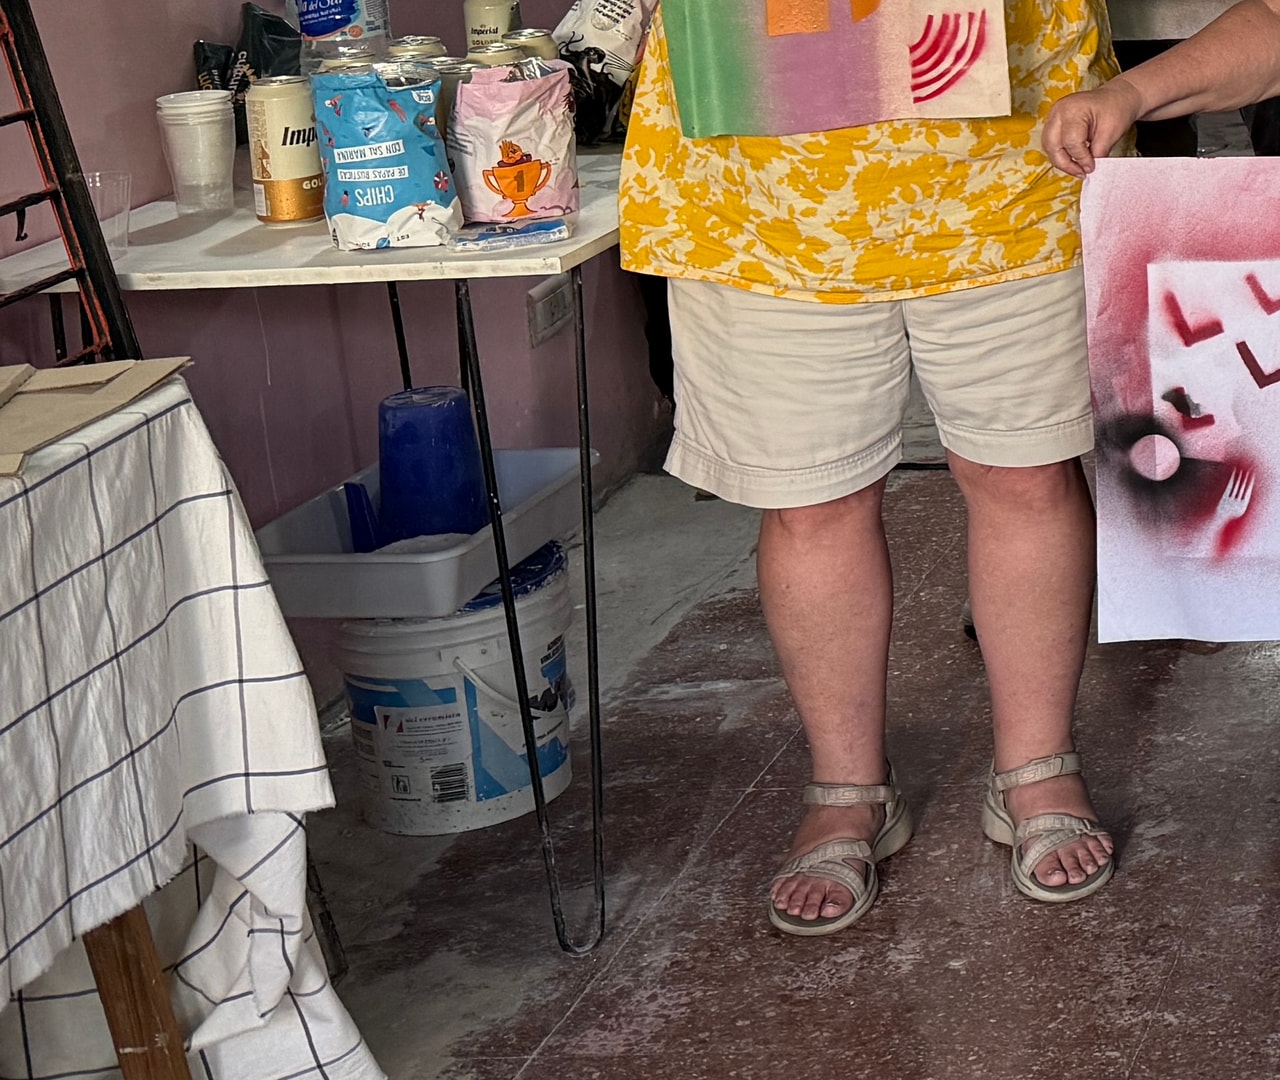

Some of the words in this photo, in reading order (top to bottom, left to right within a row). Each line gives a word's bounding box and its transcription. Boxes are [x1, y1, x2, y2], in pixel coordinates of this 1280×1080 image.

[471, 26, 499, 36] Imperial
[369, 146, 384, 157] SAL
[387, 141, 402, 154] CON
[336, 149, 366, 162] MARINA
[373, 170, 396, 179] PAPAS
[397, 169, 407, 177] DE
[514, 170, 524, 193] 1
[355, 185, 395, 207] CHIPS
